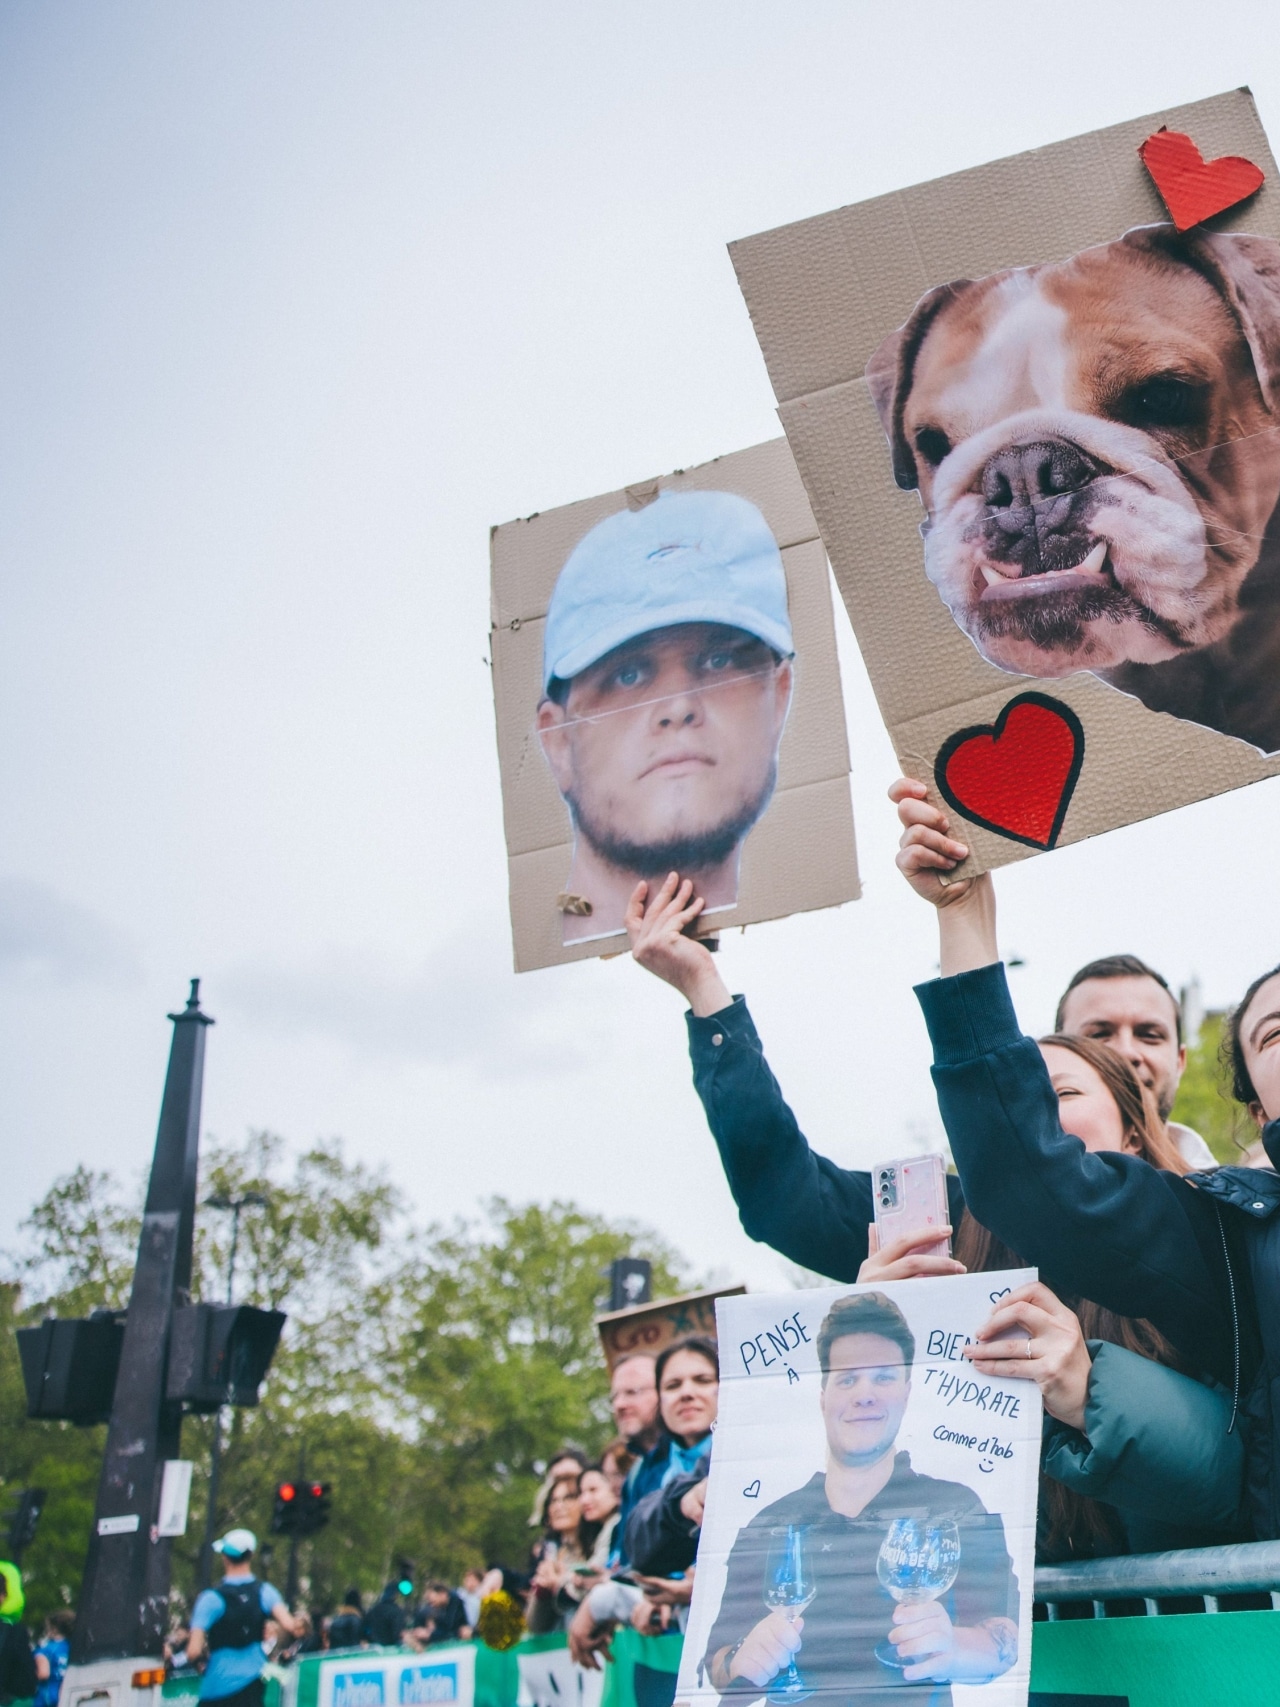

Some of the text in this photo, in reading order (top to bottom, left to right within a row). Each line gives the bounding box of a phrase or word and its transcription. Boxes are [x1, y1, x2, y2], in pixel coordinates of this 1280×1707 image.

[739, 1311, 812, 1376] PENSE
[924, 1368, 1021, 1419] T'HYDRATE
[932, 1424, 1014, 1459] Comme d'hab
